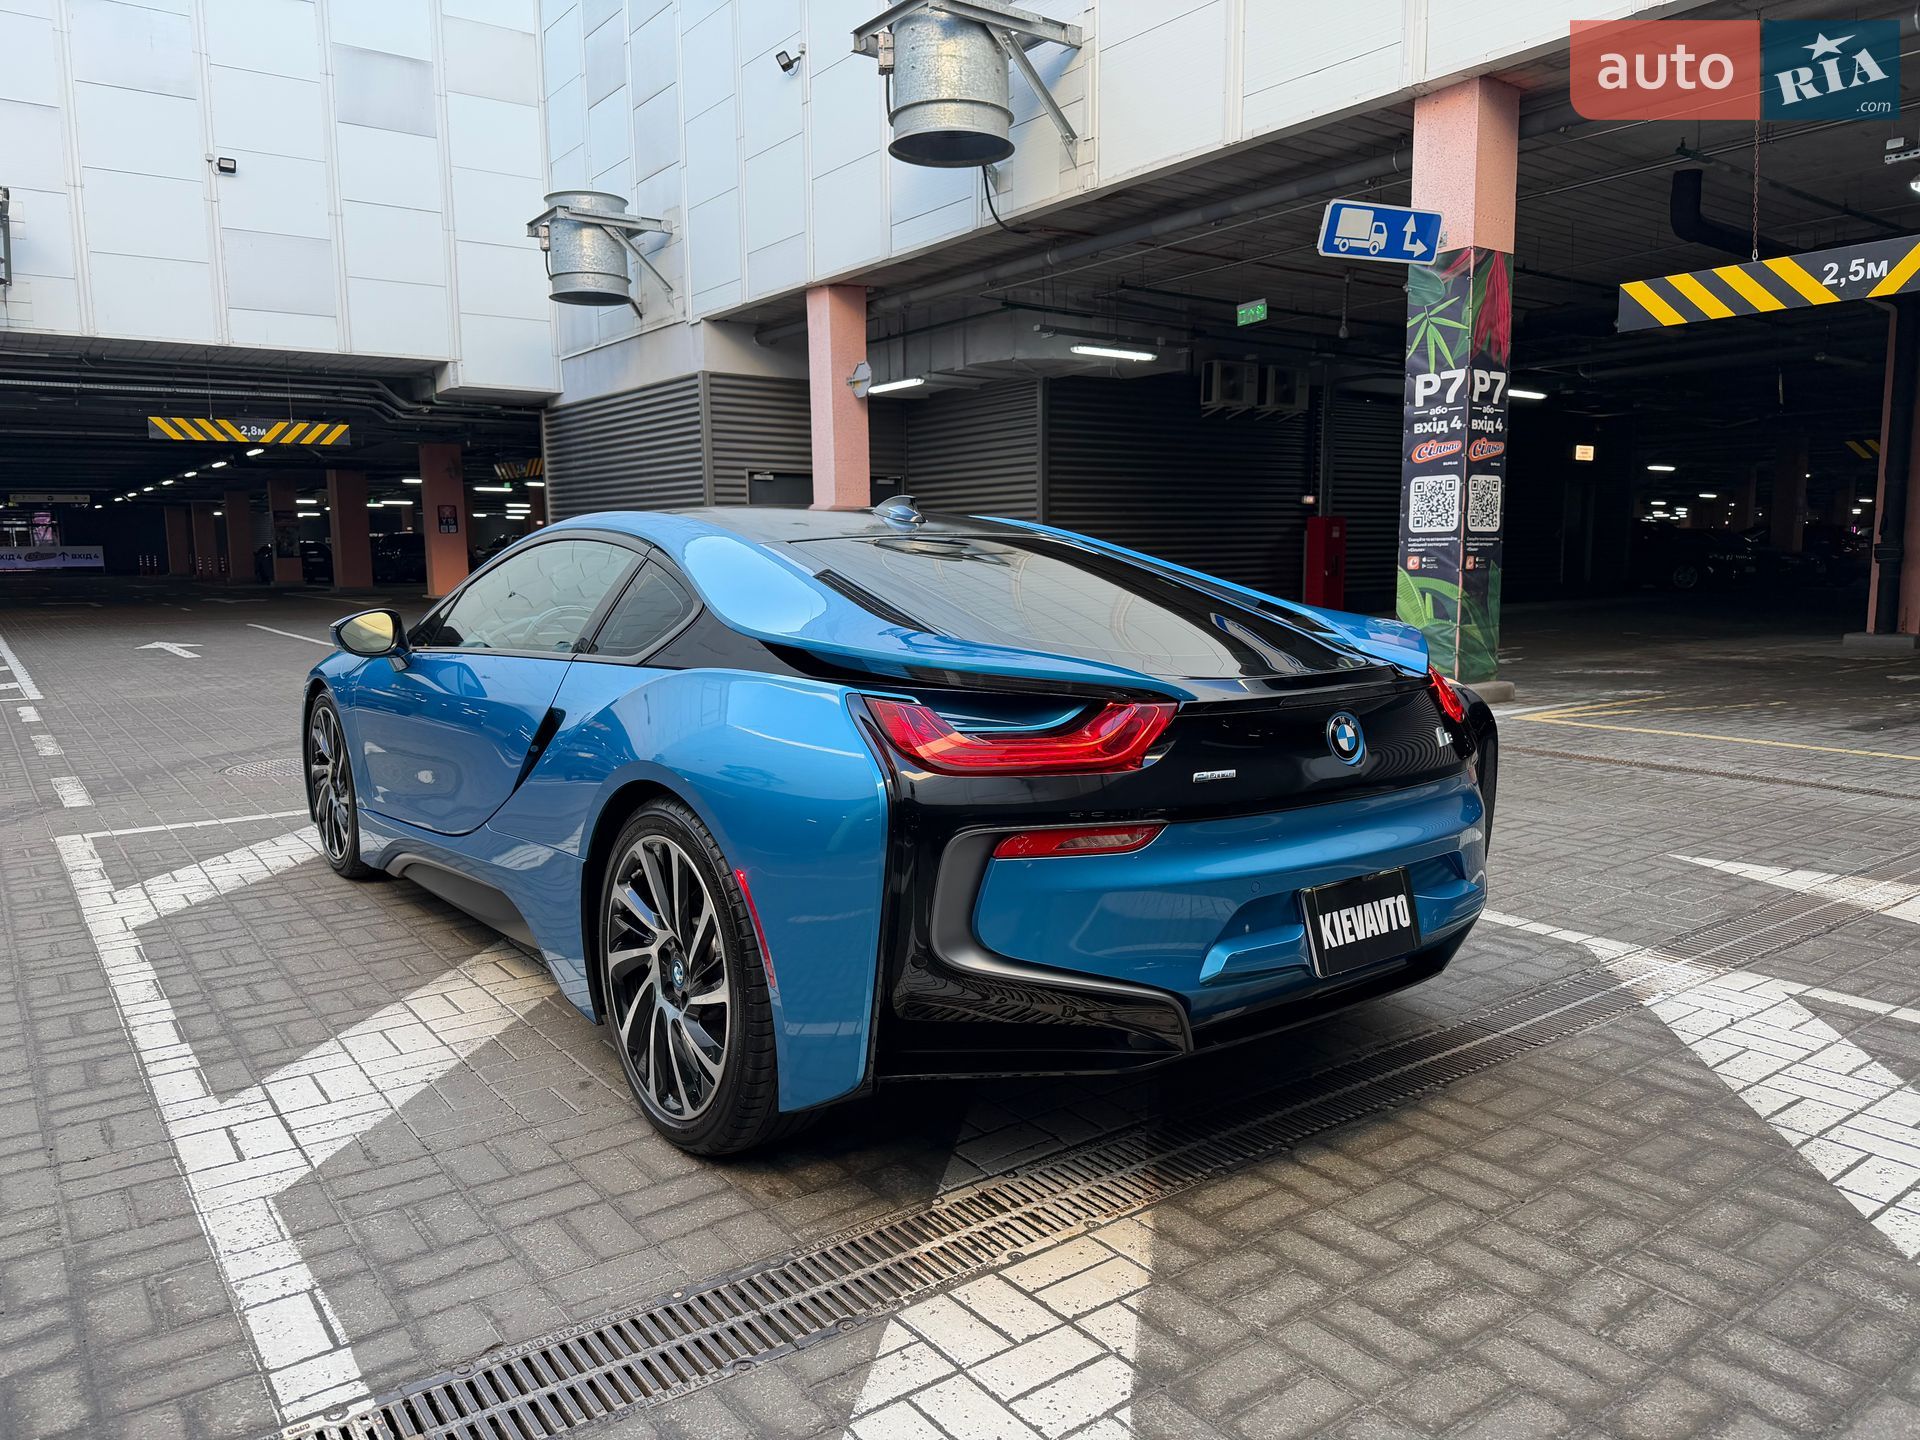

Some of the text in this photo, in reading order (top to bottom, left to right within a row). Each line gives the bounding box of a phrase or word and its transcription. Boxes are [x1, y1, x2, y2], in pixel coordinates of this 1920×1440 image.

[1414, 368, 1467, 408] P7
[1472, 368, 1507, 405] P7
[1429, 406, 1448, 416] або
[1482, 406, 1495, 415] або
[1413, 415, 1463, 434] вхід 4
[1471, 416, 1503, 433] вхід 4
[1319, 894, 1412, 950] KIEVAVTO
